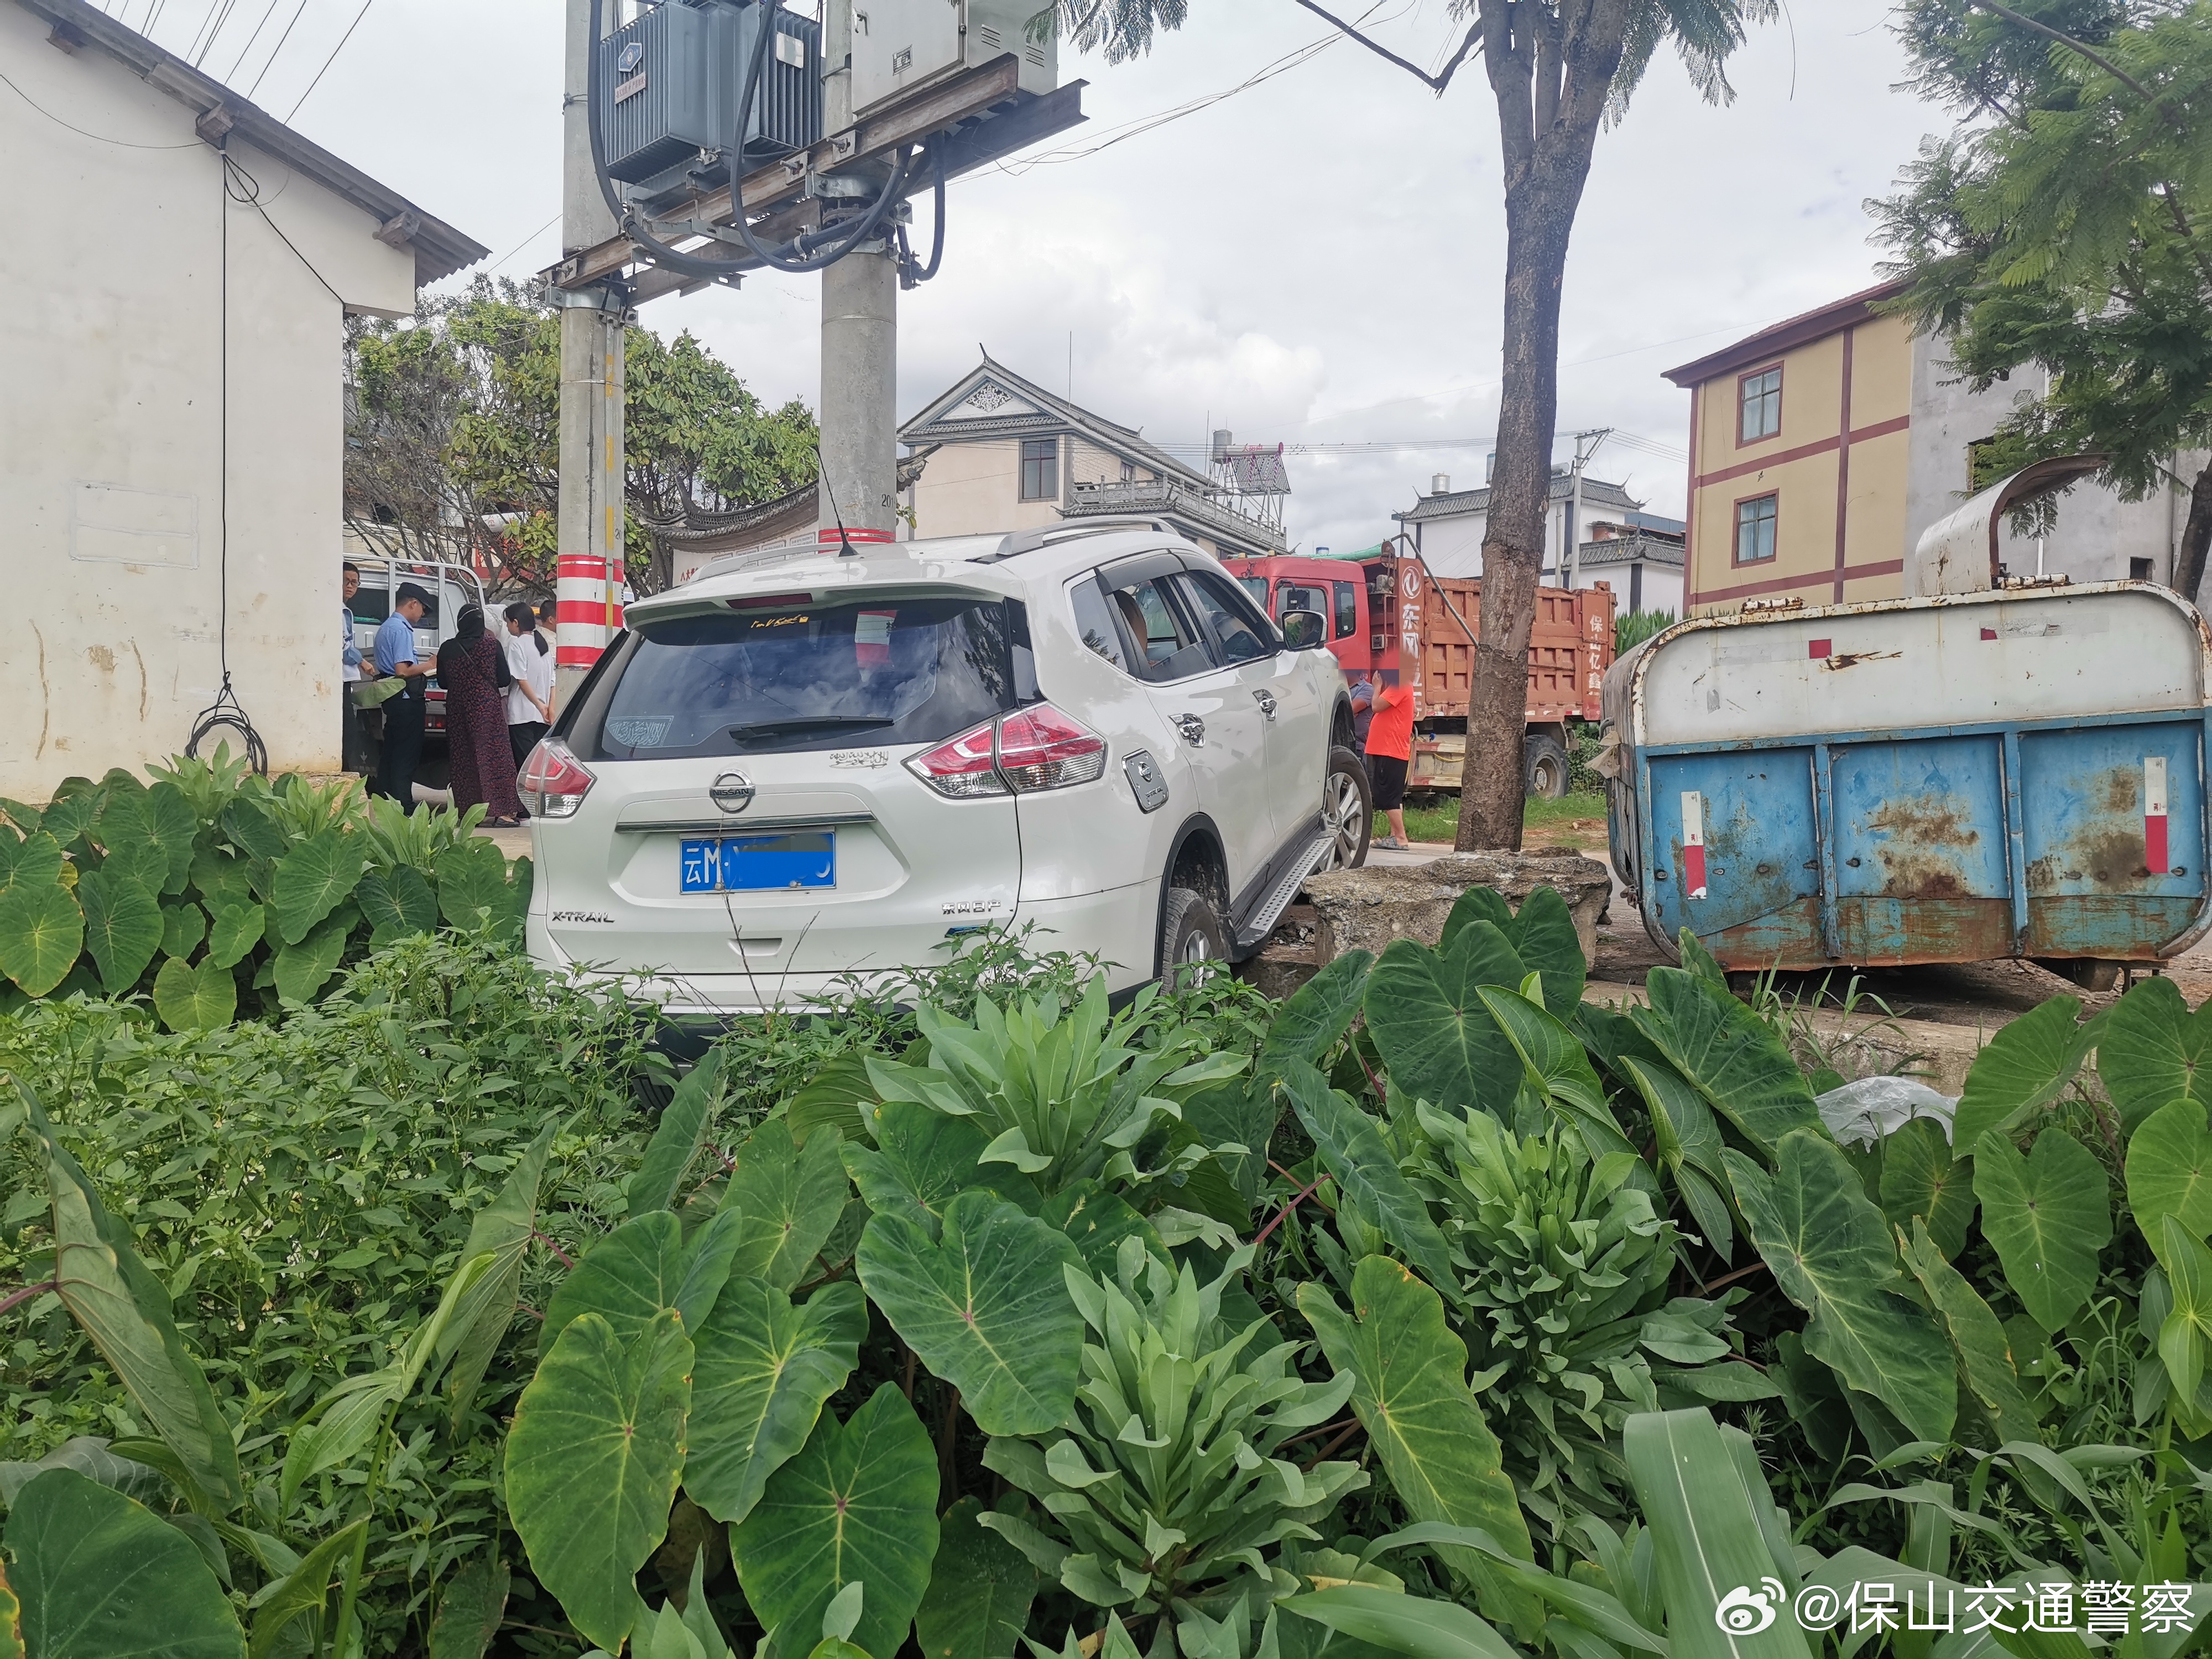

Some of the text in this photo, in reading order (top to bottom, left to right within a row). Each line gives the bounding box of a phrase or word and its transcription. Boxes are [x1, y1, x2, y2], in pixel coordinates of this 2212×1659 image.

[1402, 603, 1423, 718] 东风
[712, 787, 750, 796] NISSAN
[942, 899, 1001, 915] 东风日产
[552, 911, 615, 923] X-TRAIL
